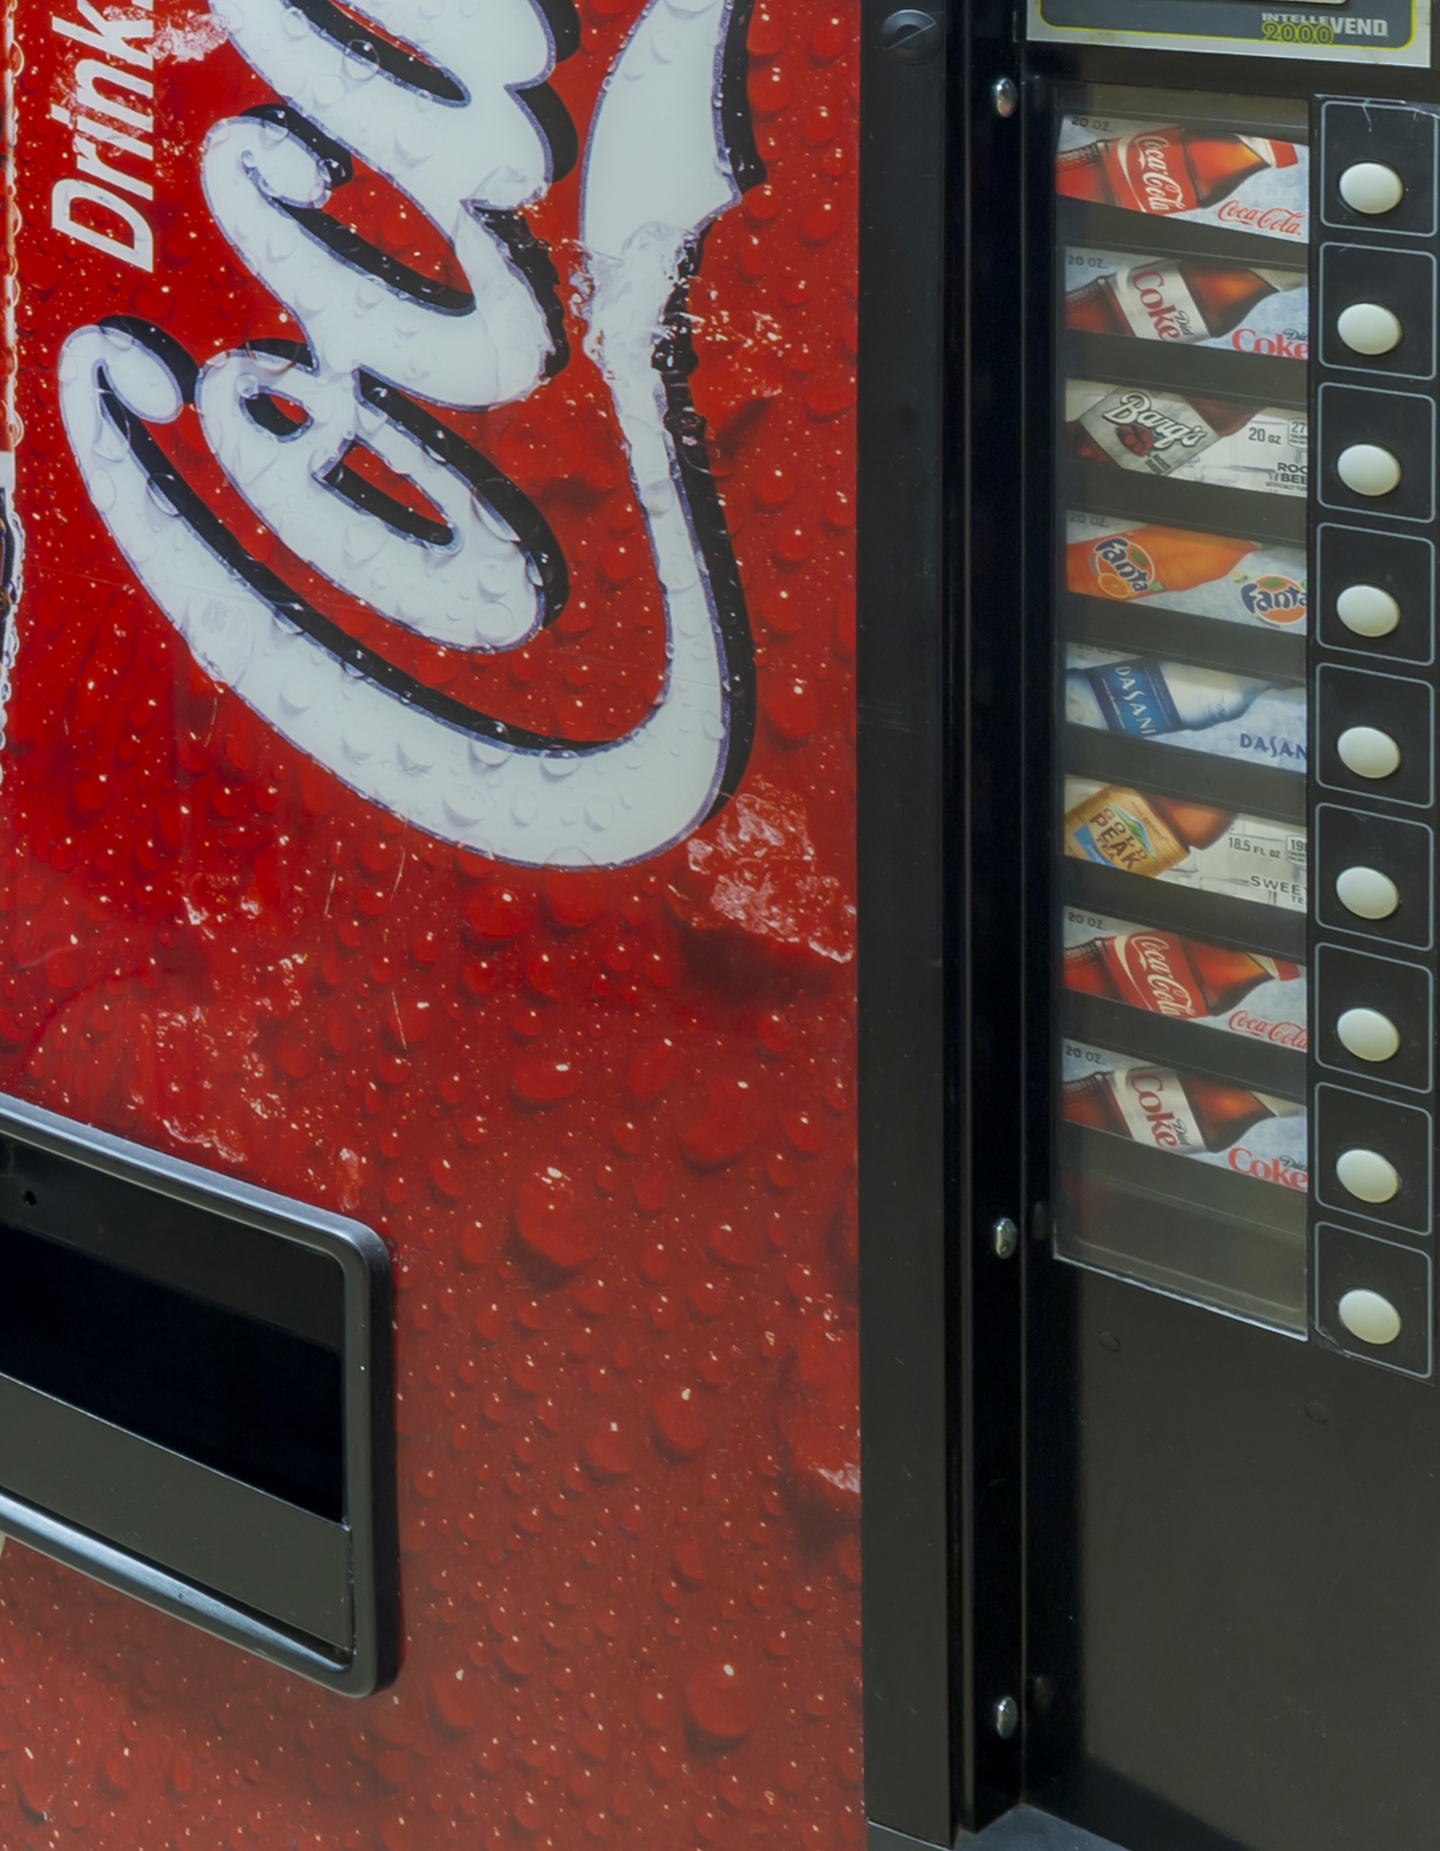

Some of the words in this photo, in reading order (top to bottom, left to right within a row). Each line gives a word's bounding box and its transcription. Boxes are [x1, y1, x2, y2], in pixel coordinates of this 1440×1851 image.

[1261, 20, 1334, 45] 2000
[1134, 135, 1185, 213] Coca-Cola
[1132, 270, 1180, 342] Coke
[1102, 391, 1206, 449] Barq's
[1249, 427, 1266, 442] 20
[1094, 537, 1148, 592] Fanta
[1240, 583, 1307, 613] Fanta
[1115, 666, 1156, 735] DASANI
[1089, 813, 1143, 870] PEAK
[1104, 808, 1149, 861] GOLD
[1229, 837, 1251, 851] 18.5
[1067, 912, 1083, 924] 20
[1131, 934, 1197, 1018] Coca-Cola
[1065, 1046, 1081, 1058] 20
[1130, 1073, 1178, 1148] Coke
